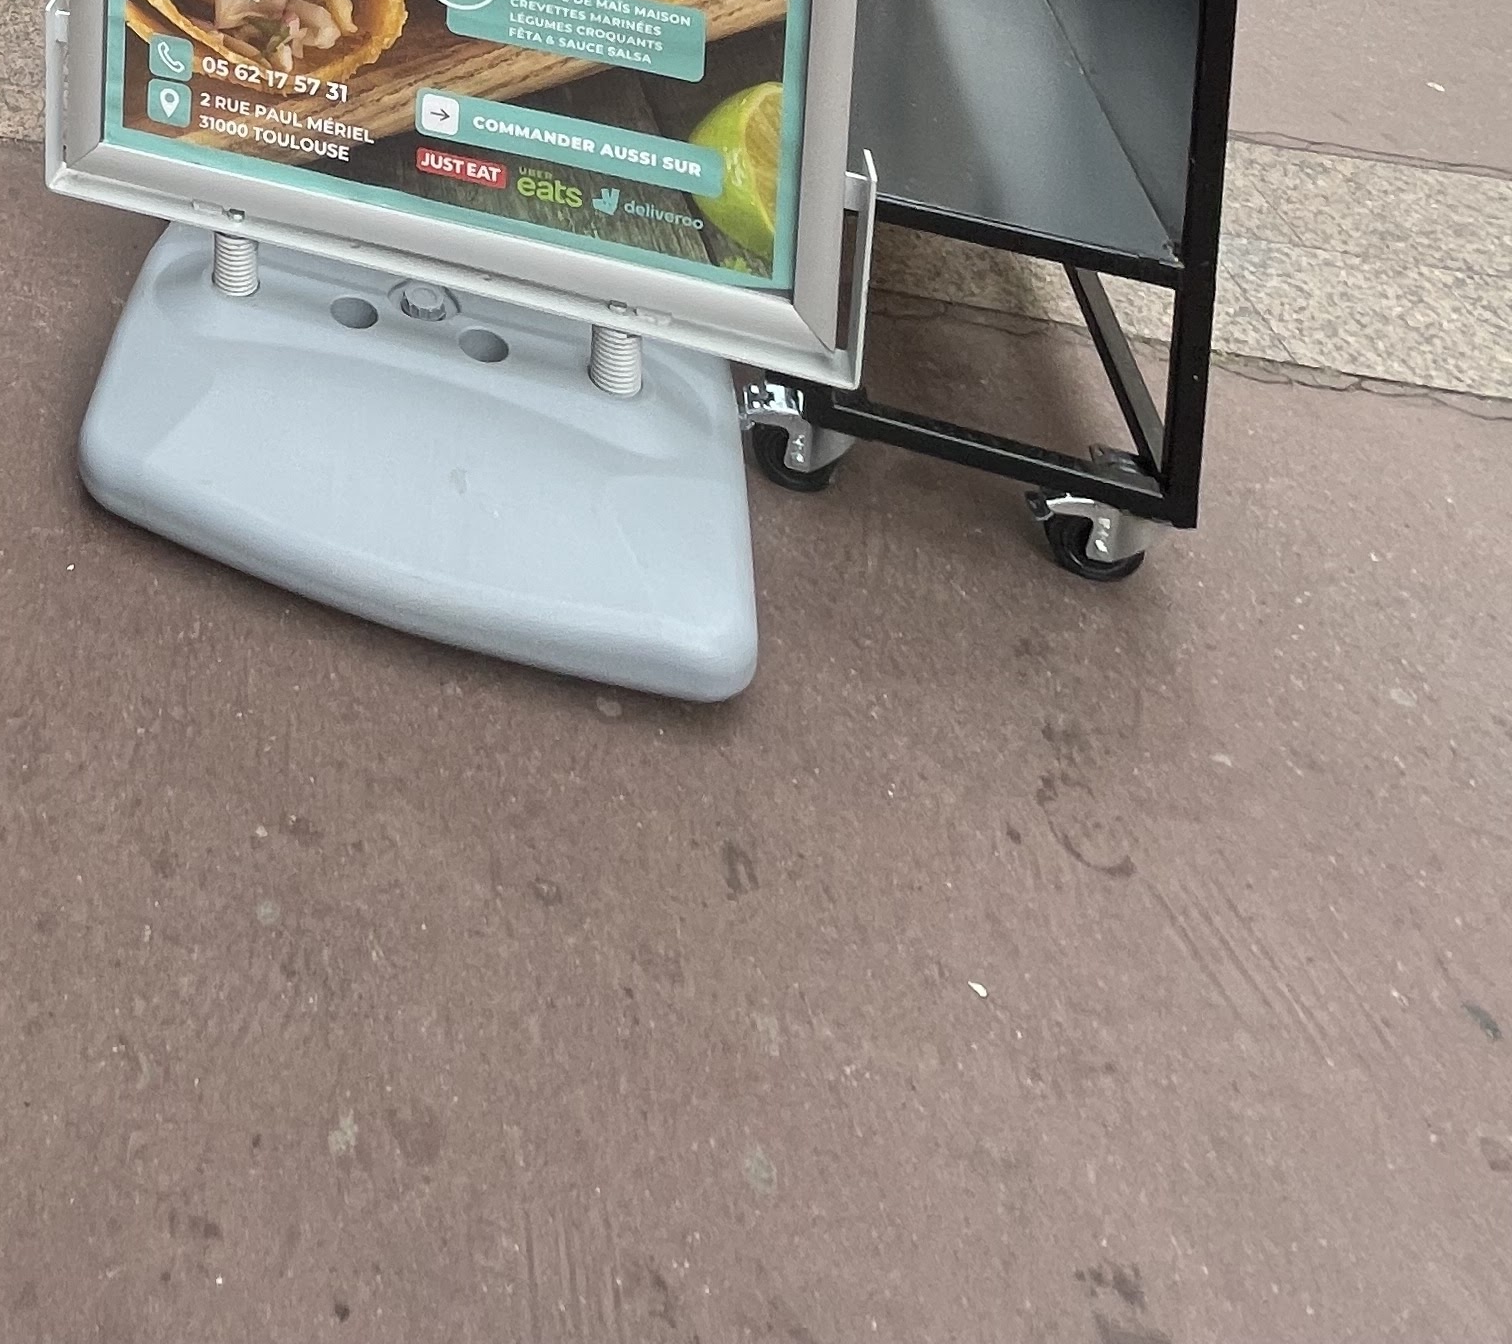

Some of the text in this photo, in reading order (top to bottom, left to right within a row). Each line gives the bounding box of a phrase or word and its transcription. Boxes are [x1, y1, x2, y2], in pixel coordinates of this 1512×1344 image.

[509, 12, 663, 52] LÉGUMES CROQUANTS
[589, 13, 663, 36] MARINÉES
[634, 6, 691, 27] MAISON
[545, 34, 556, 45] &
[558, 37, 605, 56] SAUCE
[607, 46, 652, 64] SALSA
[202, 56, 349, 103] 05 62 17 57 31
[199, 92, 376, 145] 2 RUE PAUL MÉRIEL
[199, 114, 350, 162] 31000 TOULOUSE
[472, 115, 702, 178] COMMANDER AUSSI SUR
[420, 152, 502, 183] JUST EAT
[518, 166, 553, 180] UBER
[516, 175, 583, 208] eats
[623, 200, 704, 230] deliveroo
